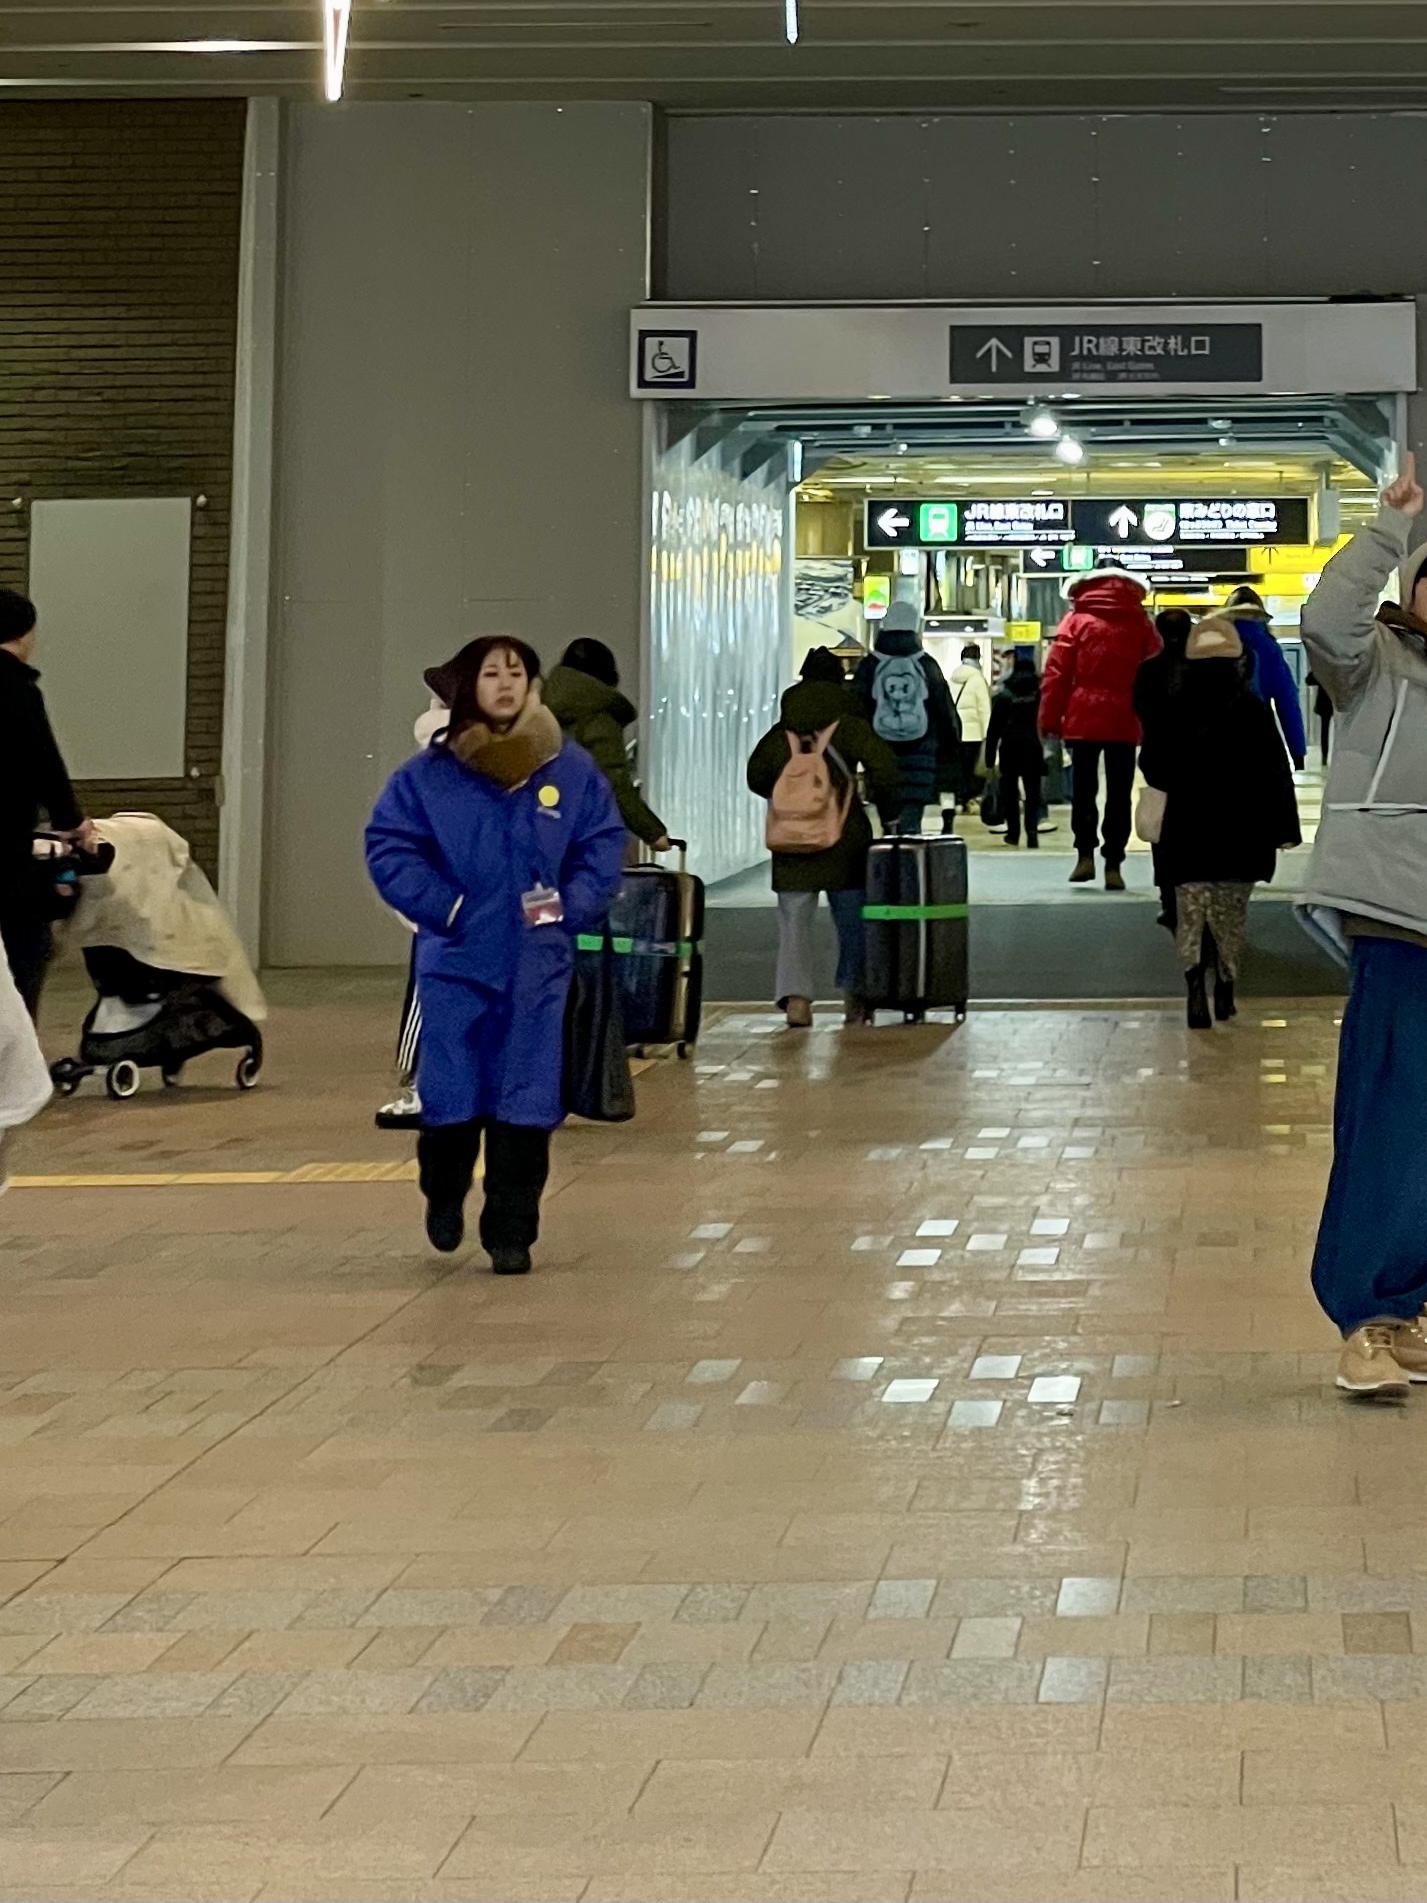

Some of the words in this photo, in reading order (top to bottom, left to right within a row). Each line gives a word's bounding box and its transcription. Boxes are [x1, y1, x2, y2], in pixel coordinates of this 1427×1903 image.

[1069, 336, 1211, 356] JR線東改札口
